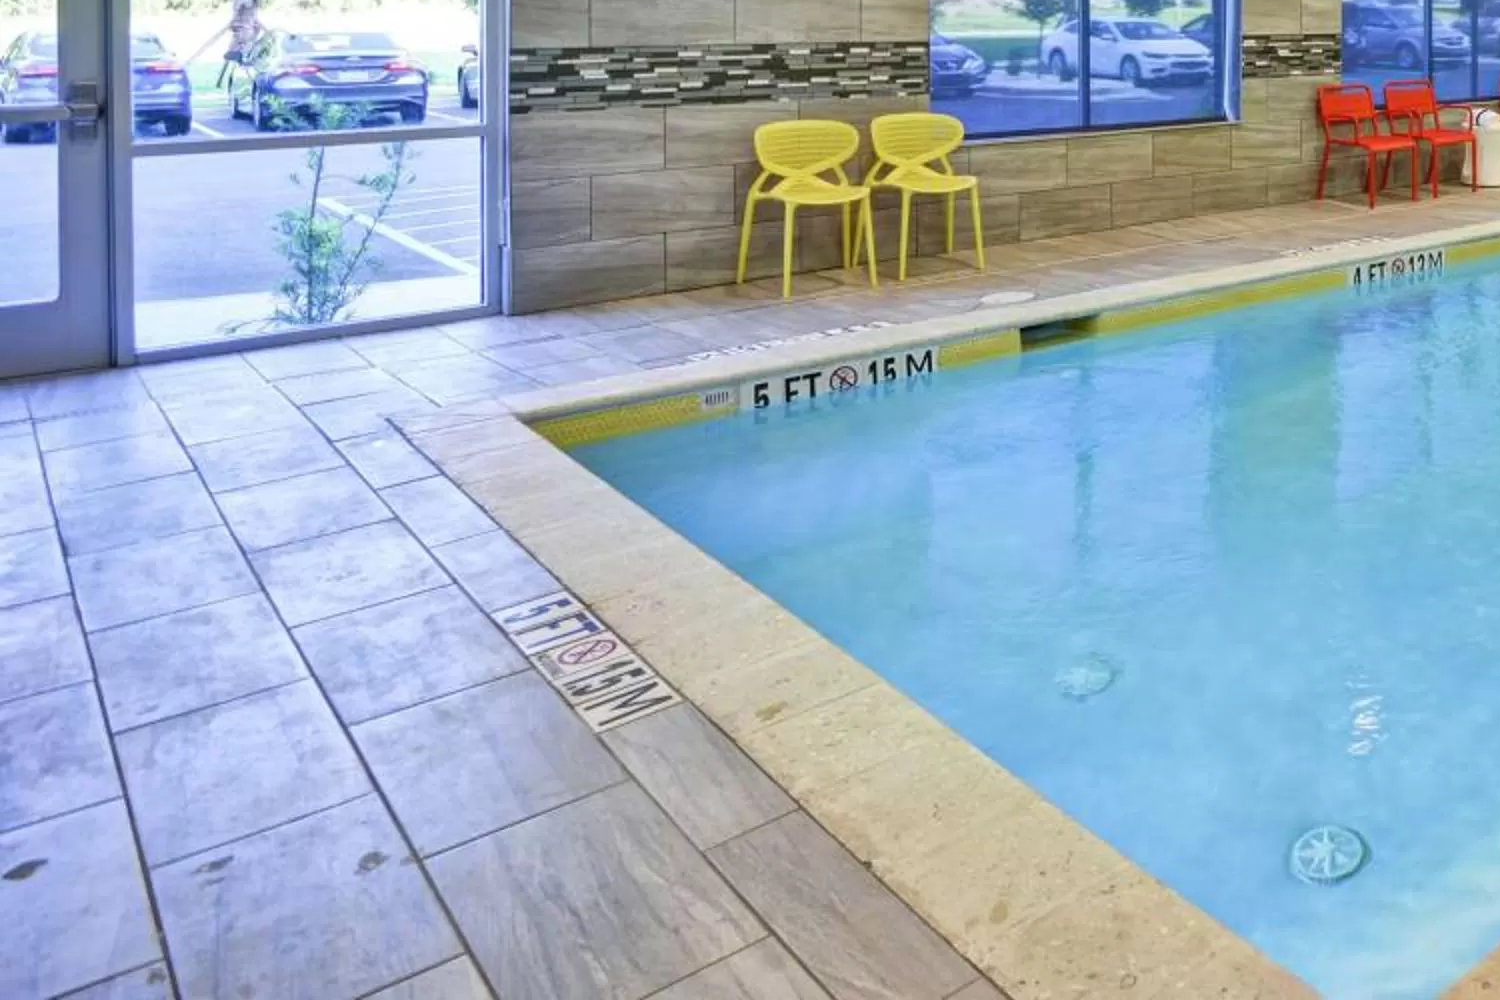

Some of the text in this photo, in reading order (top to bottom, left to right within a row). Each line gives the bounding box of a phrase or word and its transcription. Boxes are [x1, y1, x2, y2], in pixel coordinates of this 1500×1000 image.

[1369, 261, 1386, 282] FT
[753, 382, 770, 409] 5
[784, 372, 822, 403] FT
[906, 350, 933, 377] M
[503, 597, 573, 625] 5
[514, 609, 600, 650] FT
[583, 680, 674, 727] M
